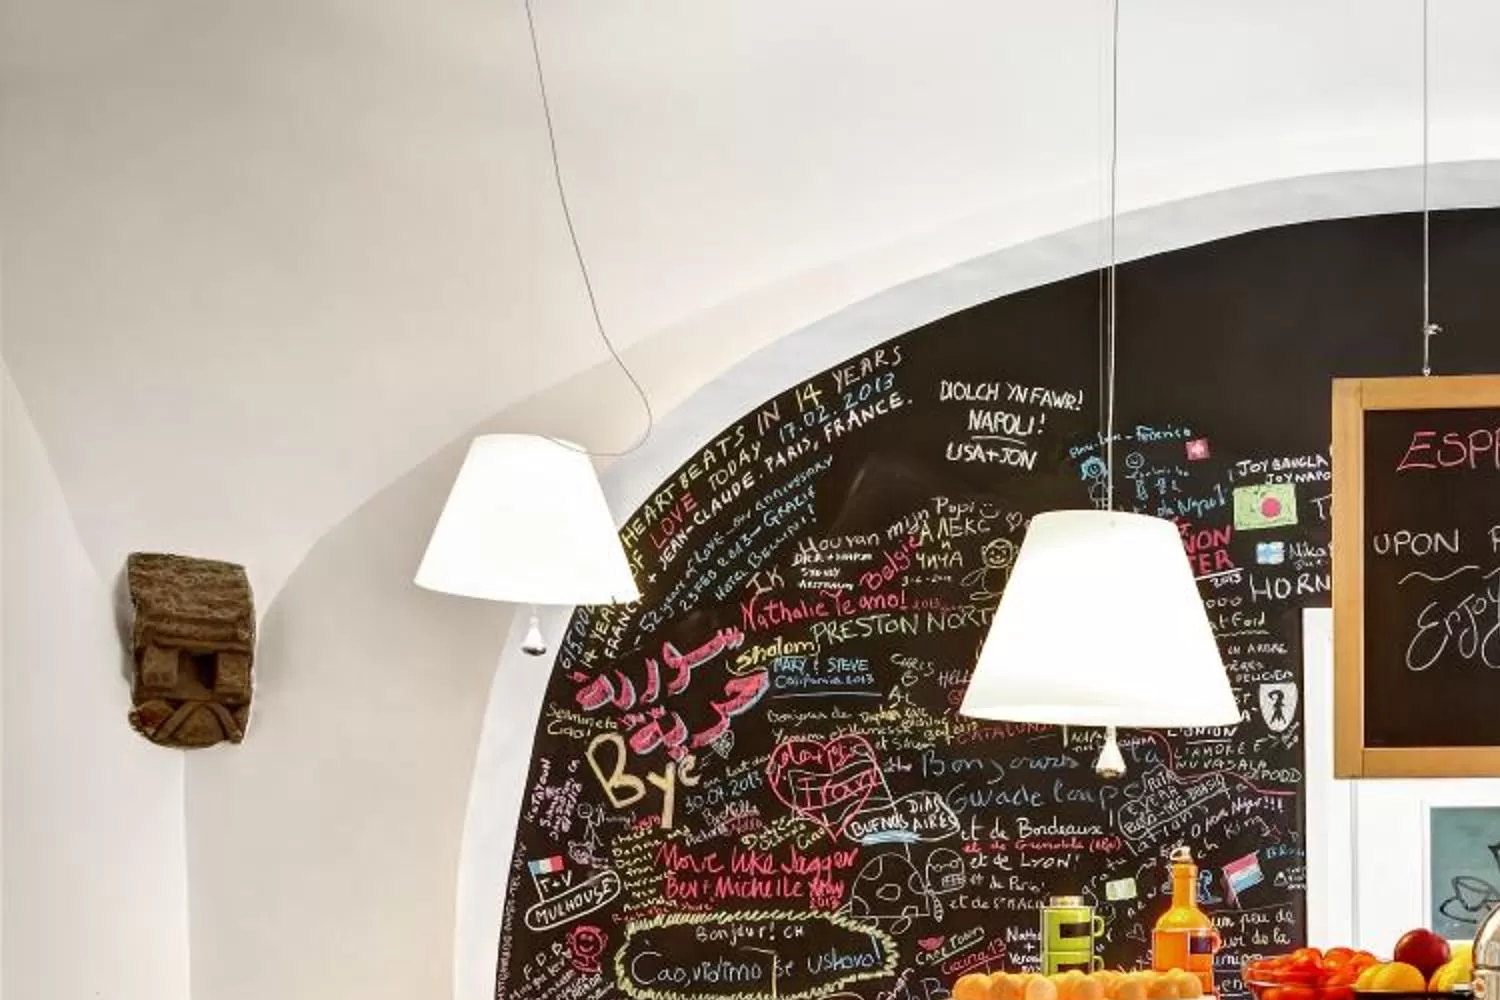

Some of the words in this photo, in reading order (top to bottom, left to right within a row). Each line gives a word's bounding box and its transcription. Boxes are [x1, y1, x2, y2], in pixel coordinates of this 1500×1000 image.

[831, 346, 902, 393] YEARS
[651, 491, 698, 549] LOVE
[708, 440, 761, 491] TODAY
[1373, 527, 1462, 557] UPON
[810, 612, 919, 645] PRESTON
[827, 658, 869, 672] STEVE
[585, 731, 701, 829] Bye
